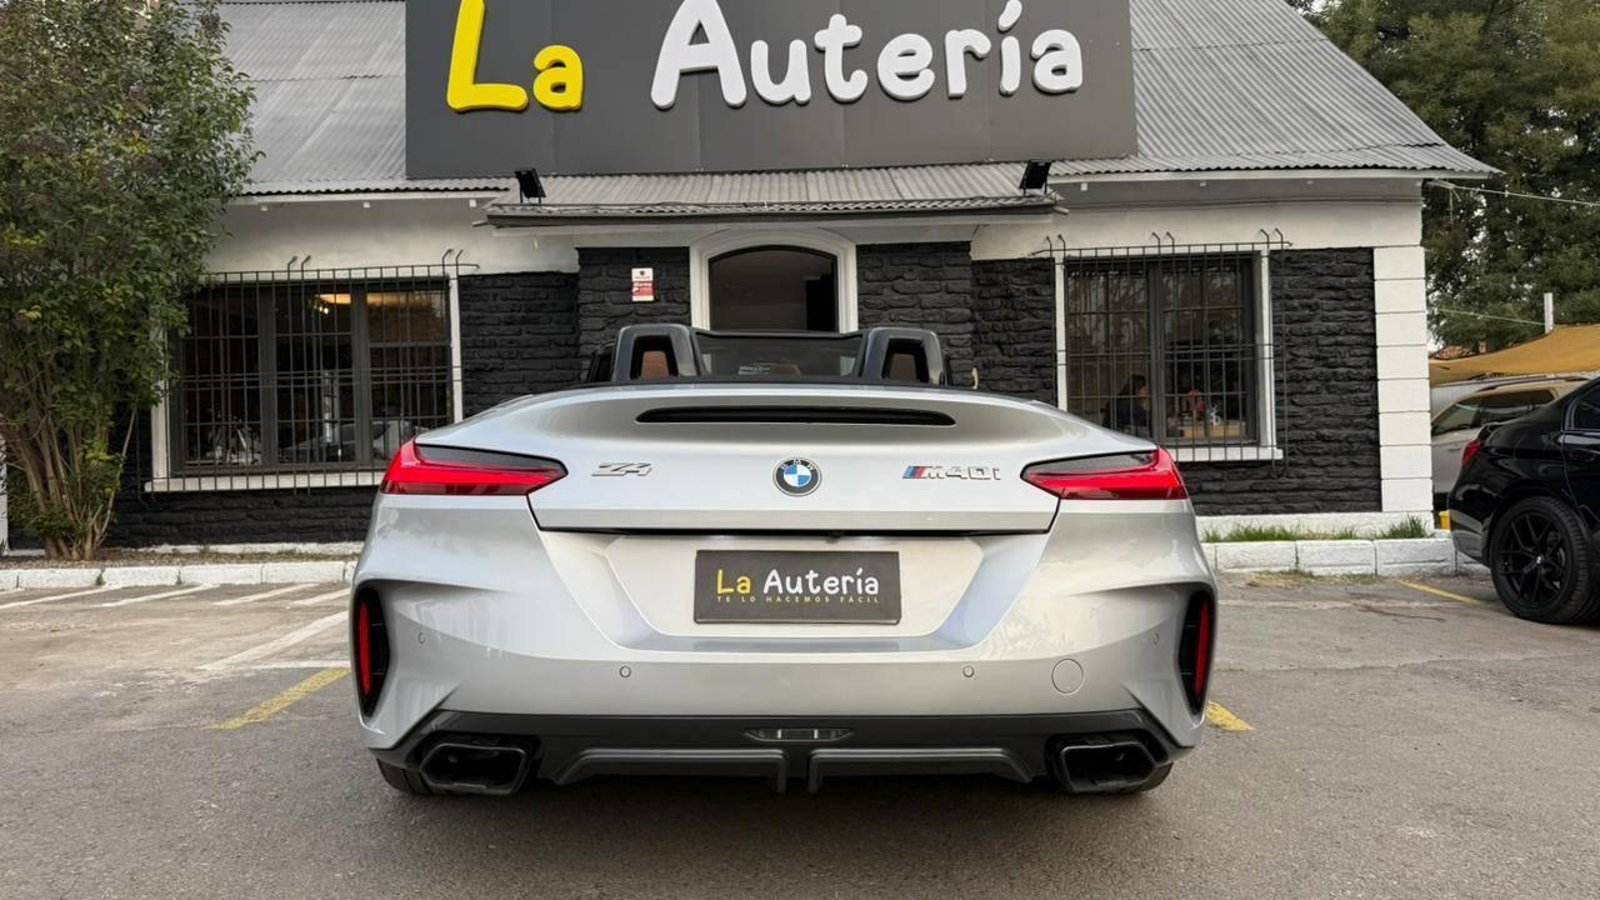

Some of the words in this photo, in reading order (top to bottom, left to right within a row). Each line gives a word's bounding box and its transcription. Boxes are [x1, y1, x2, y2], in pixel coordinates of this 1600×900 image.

[448, 0, 584, 109] La
[650, 0, 1084, 109] Autería
[591, 462, 652, 477] Z4
[717, 569, 751, 594] La
[763, 568, 879, 594] Autería
